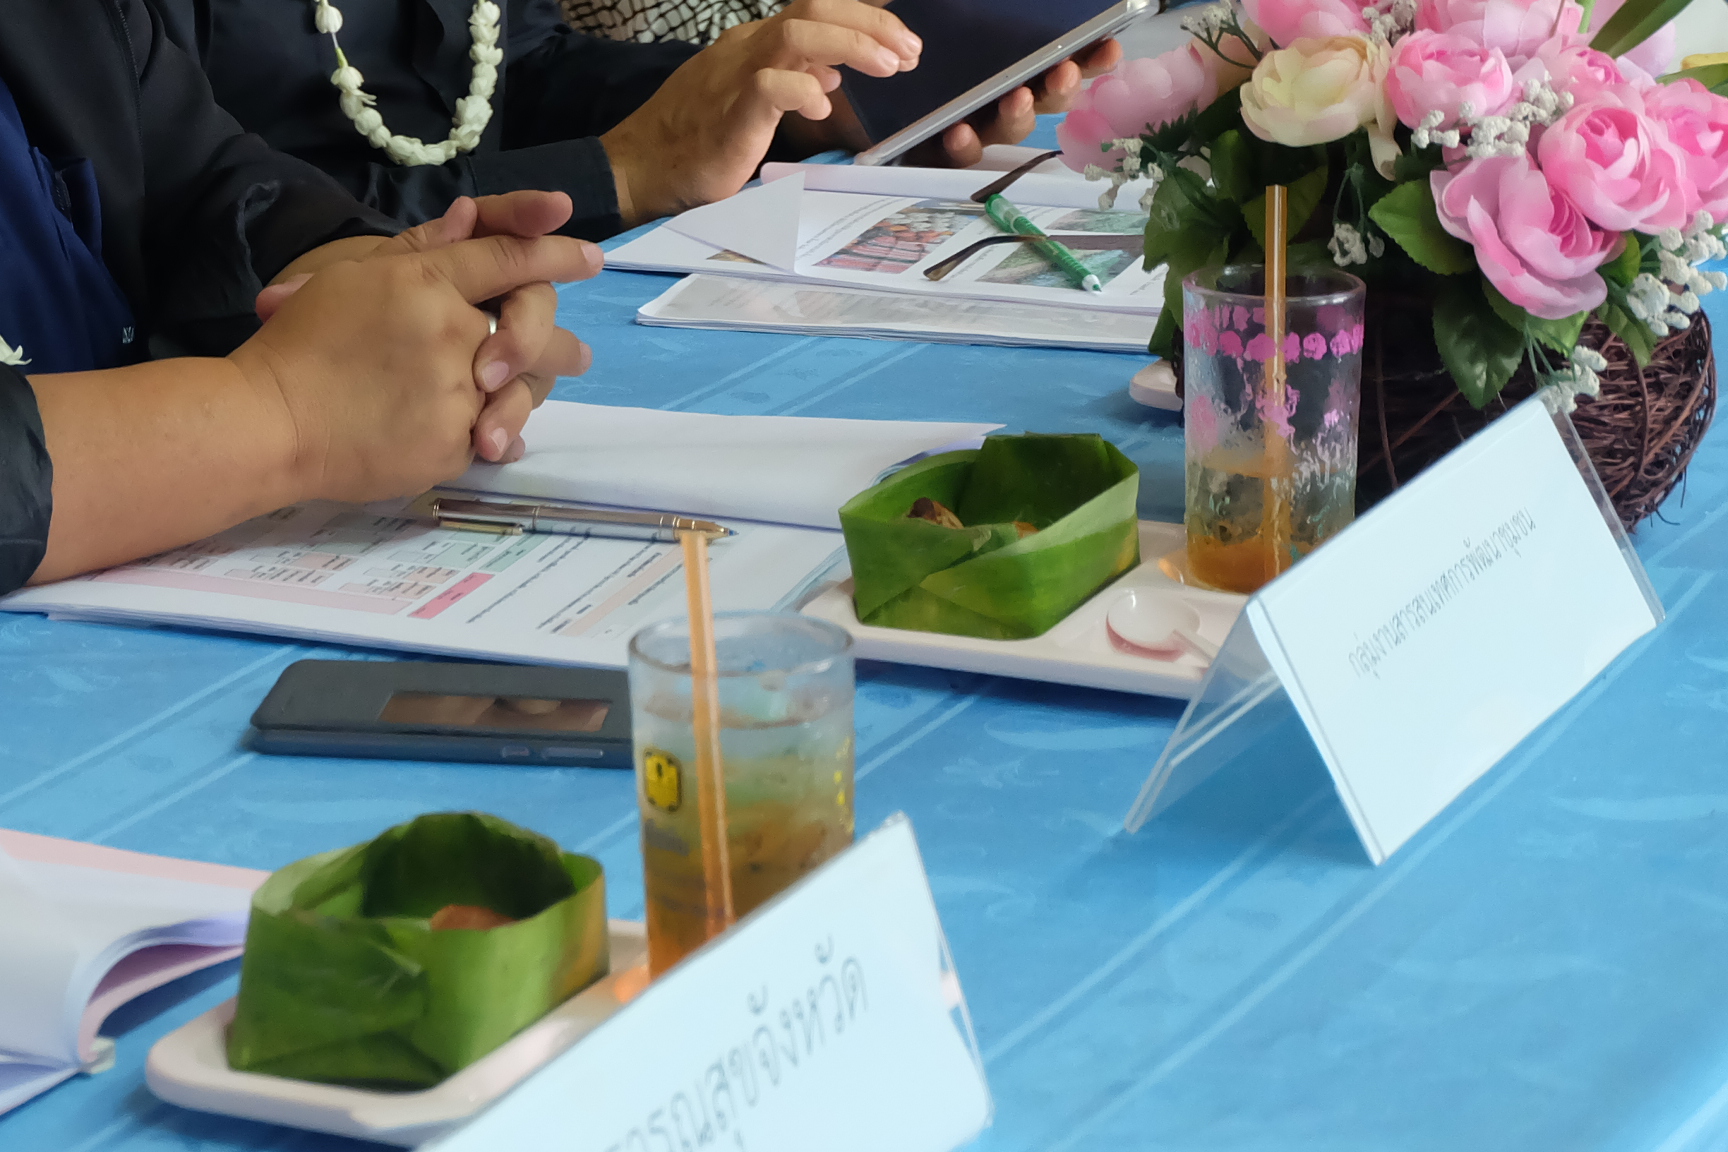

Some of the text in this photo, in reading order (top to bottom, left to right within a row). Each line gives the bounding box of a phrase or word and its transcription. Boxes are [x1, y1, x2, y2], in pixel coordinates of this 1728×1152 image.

[603, 932, 869, 1152] รณสุขจังหวัด
